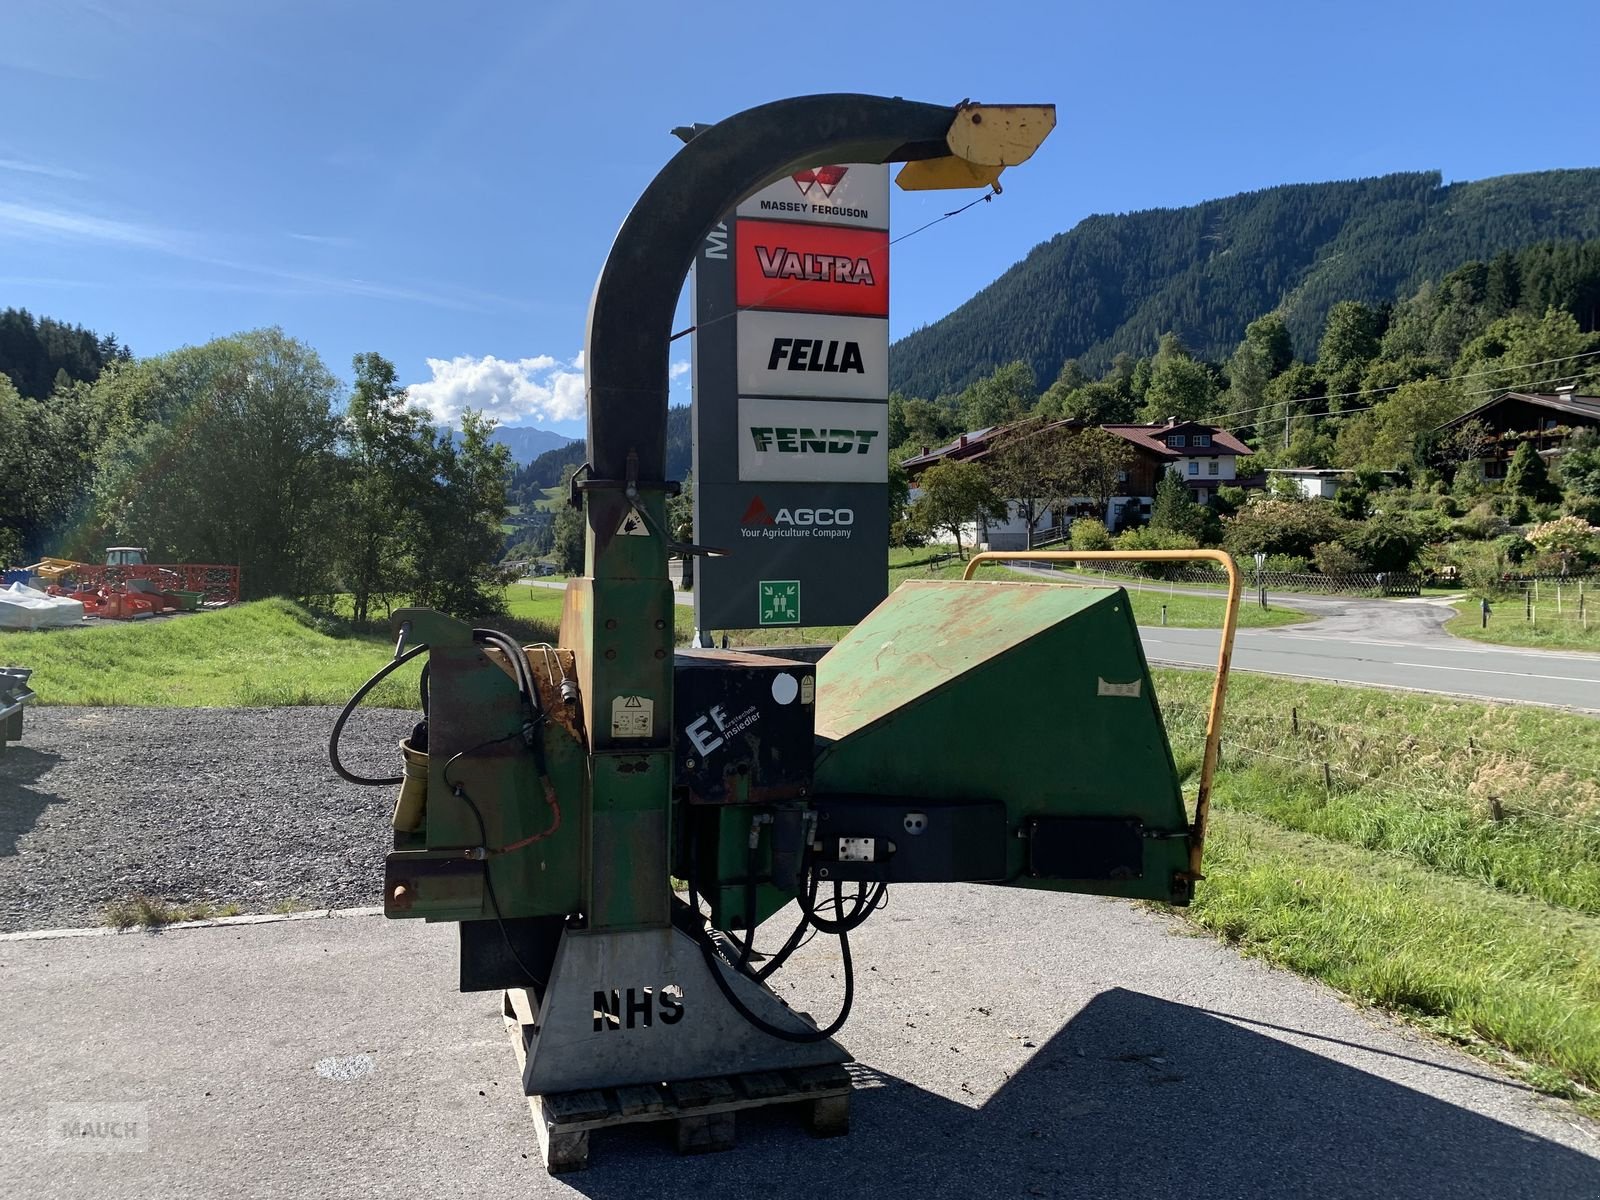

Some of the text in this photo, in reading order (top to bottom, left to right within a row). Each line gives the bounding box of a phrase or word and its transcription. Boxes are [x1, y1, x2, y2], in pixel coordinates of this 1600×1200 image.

[760, 200, 868, 219] MASSEY FERGUSON
[754, 246, 875, 286] VALTRA
[767, 338, 865, 374] FELLA
[750, 427, 879, 454] FENDT
[774, 508, 854, 526] AGCO
[741, 528, 852, 540] Your Agriculture Company
[593, 984, 685, 1032] NHS
